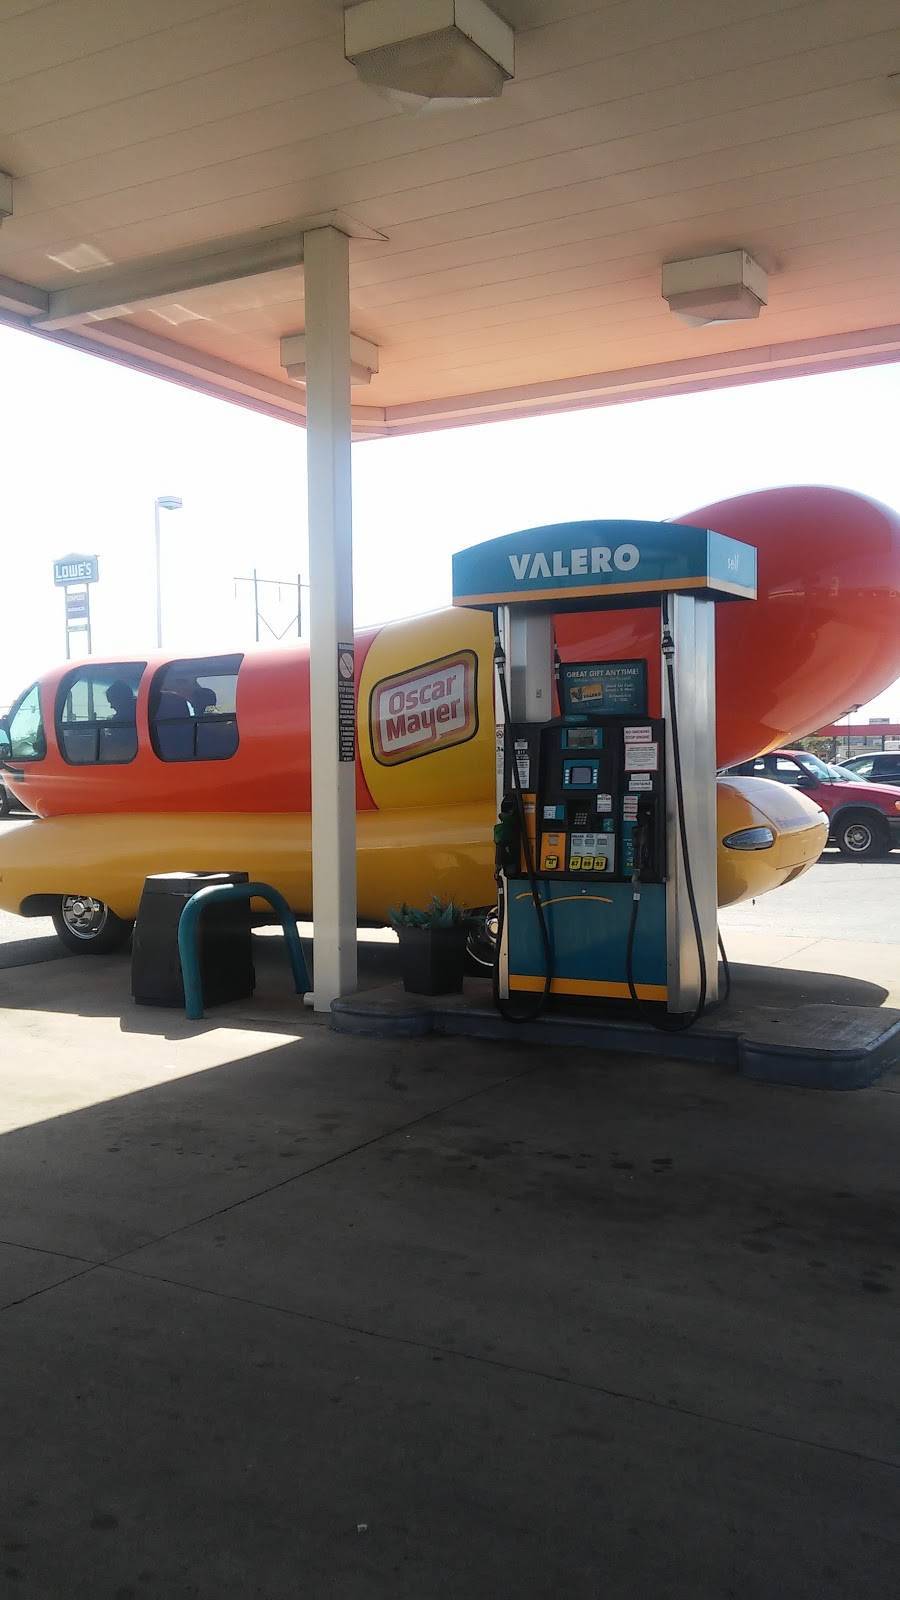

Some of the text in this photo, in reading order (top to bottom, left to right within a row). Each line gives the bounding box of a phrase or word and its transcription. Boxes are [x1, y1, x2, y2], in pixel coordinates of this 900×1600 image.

[55, 561, 92, 579] LOWE'S
[508, 543, 640, 580] VALERO
[566, 668, 640, 678] GREAT GIFT ANYTIME!
[388, 674, 457, 715] Oscar
[385, 698, 461, 742] Mayer
